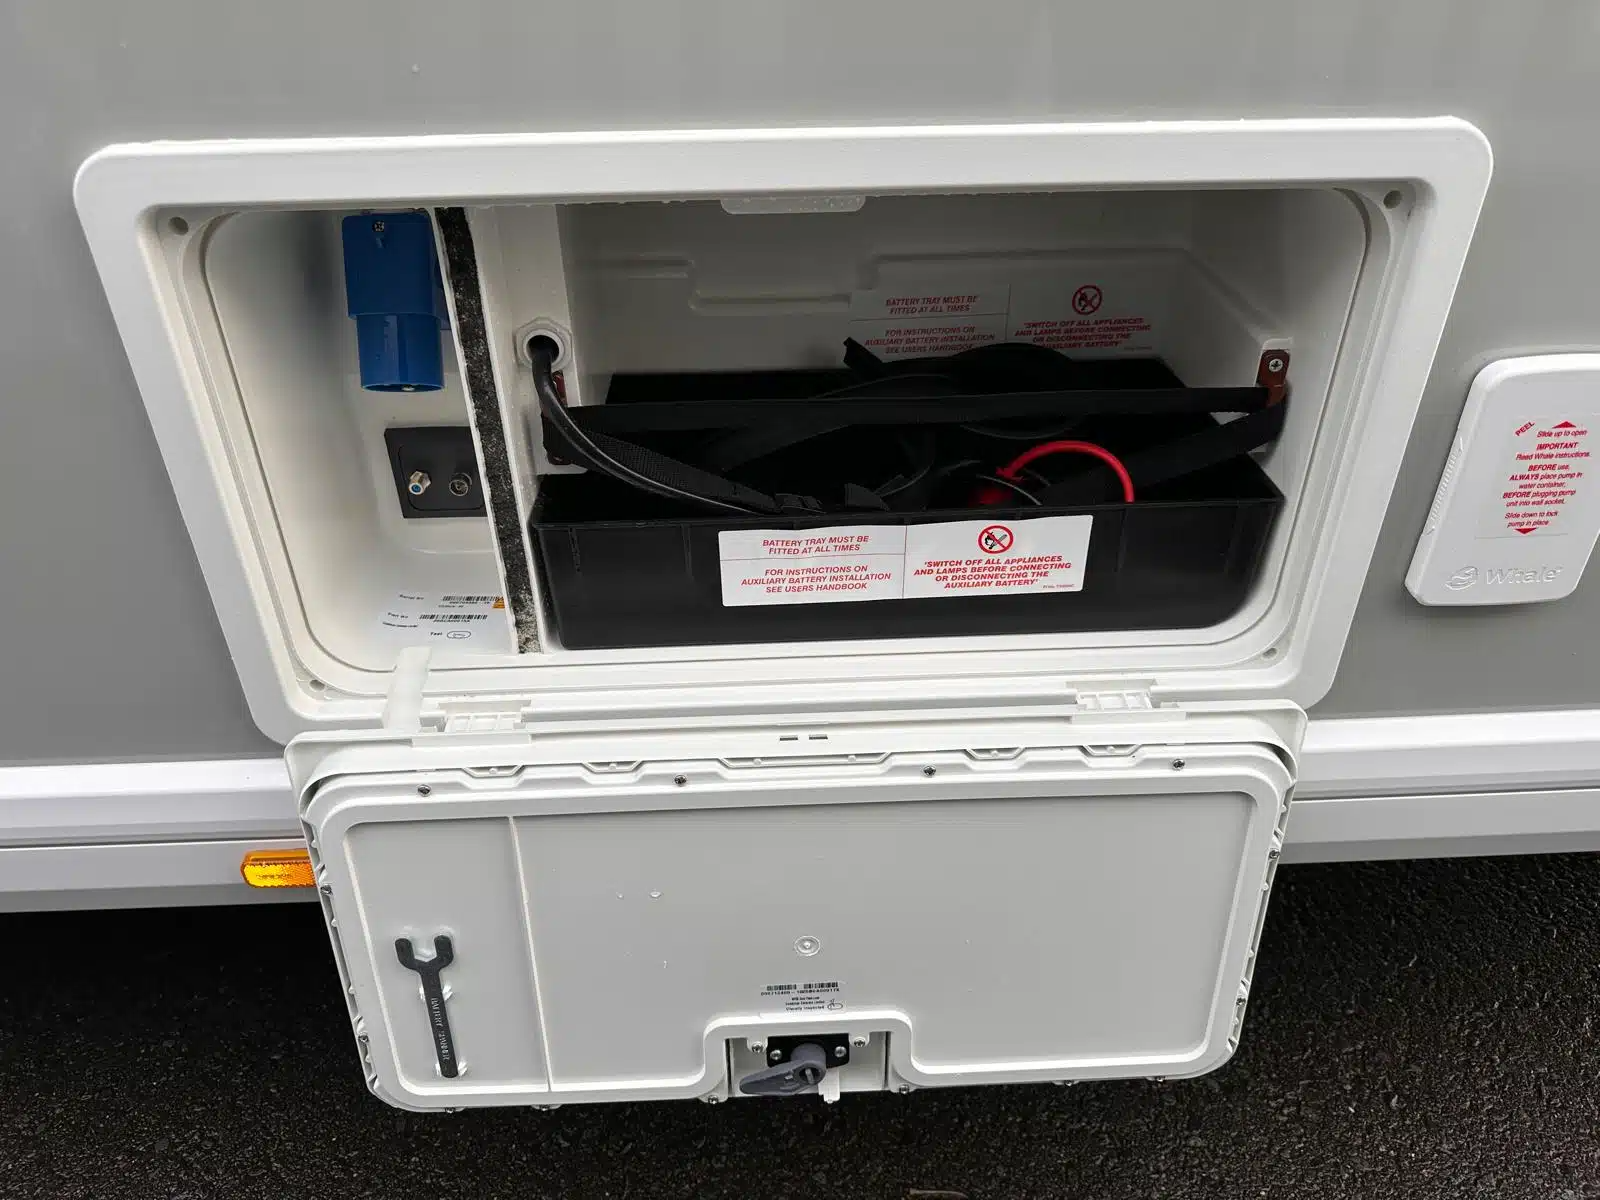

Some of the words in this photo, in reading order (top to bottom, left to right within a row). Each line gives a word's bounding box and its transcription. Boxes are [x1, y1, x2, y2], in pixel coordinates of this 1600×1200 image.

[886, 298, 919, 306] BATTERY
[943, 296, 965, 304] MUST
[903, 327, 960, 336] INSTRUCTIONS
[941, 334, 995, 343] INSTALLATION
[1515, 422, 1535, 436] PEEL
[1004, 556, 1062, 564] APPLIANCES
[786, 566, 851, 575] INSTRUCTIONS
[1009, 563, 1072, 571] CONNECTING
[830, 573, 891, 582] INSTALLATION
[951, 572, 1029, 580] DISCONNECTING
[1486, 566, 1557, 584] Whale
